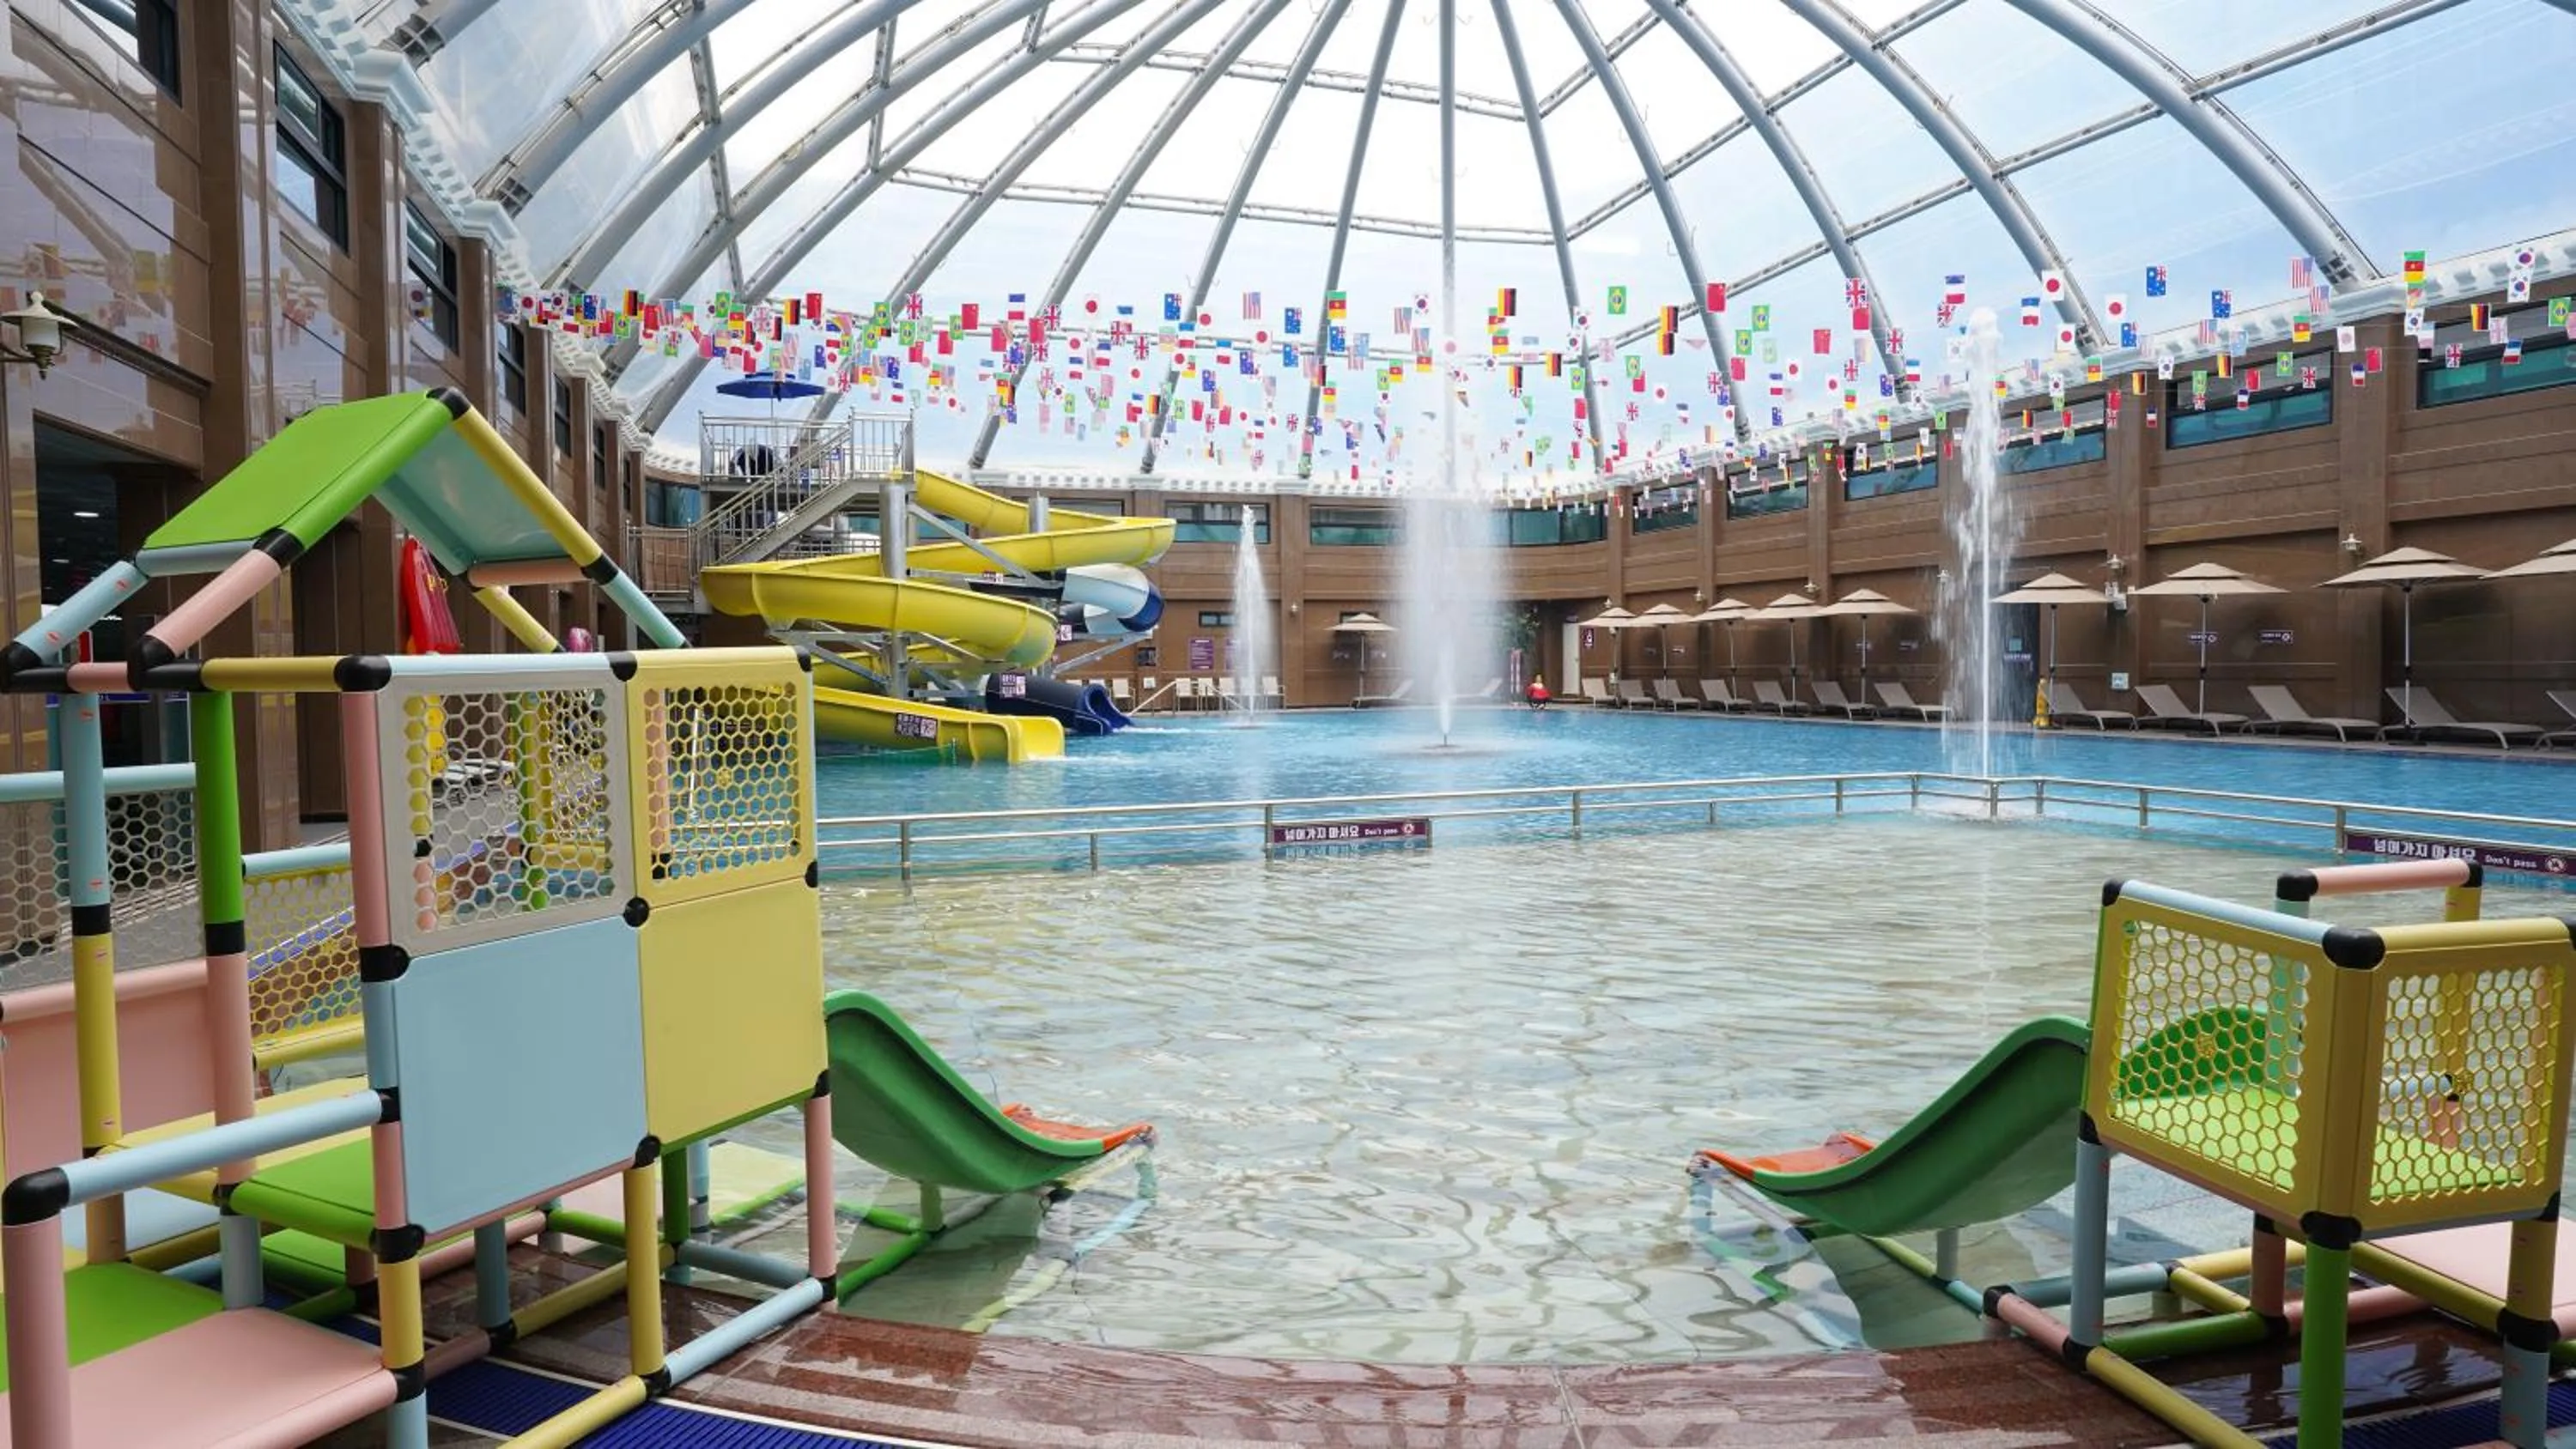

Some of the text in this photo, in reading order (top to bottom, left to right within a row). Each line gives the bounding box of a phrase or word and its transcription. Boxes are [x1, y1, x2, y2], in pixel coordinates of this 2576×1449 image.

[1285, 828, 1327, 840] 넘어가지
[2374, 839, 2428, 858] 넘어가지
[2485, 854, 2537, 868] Don't pass
